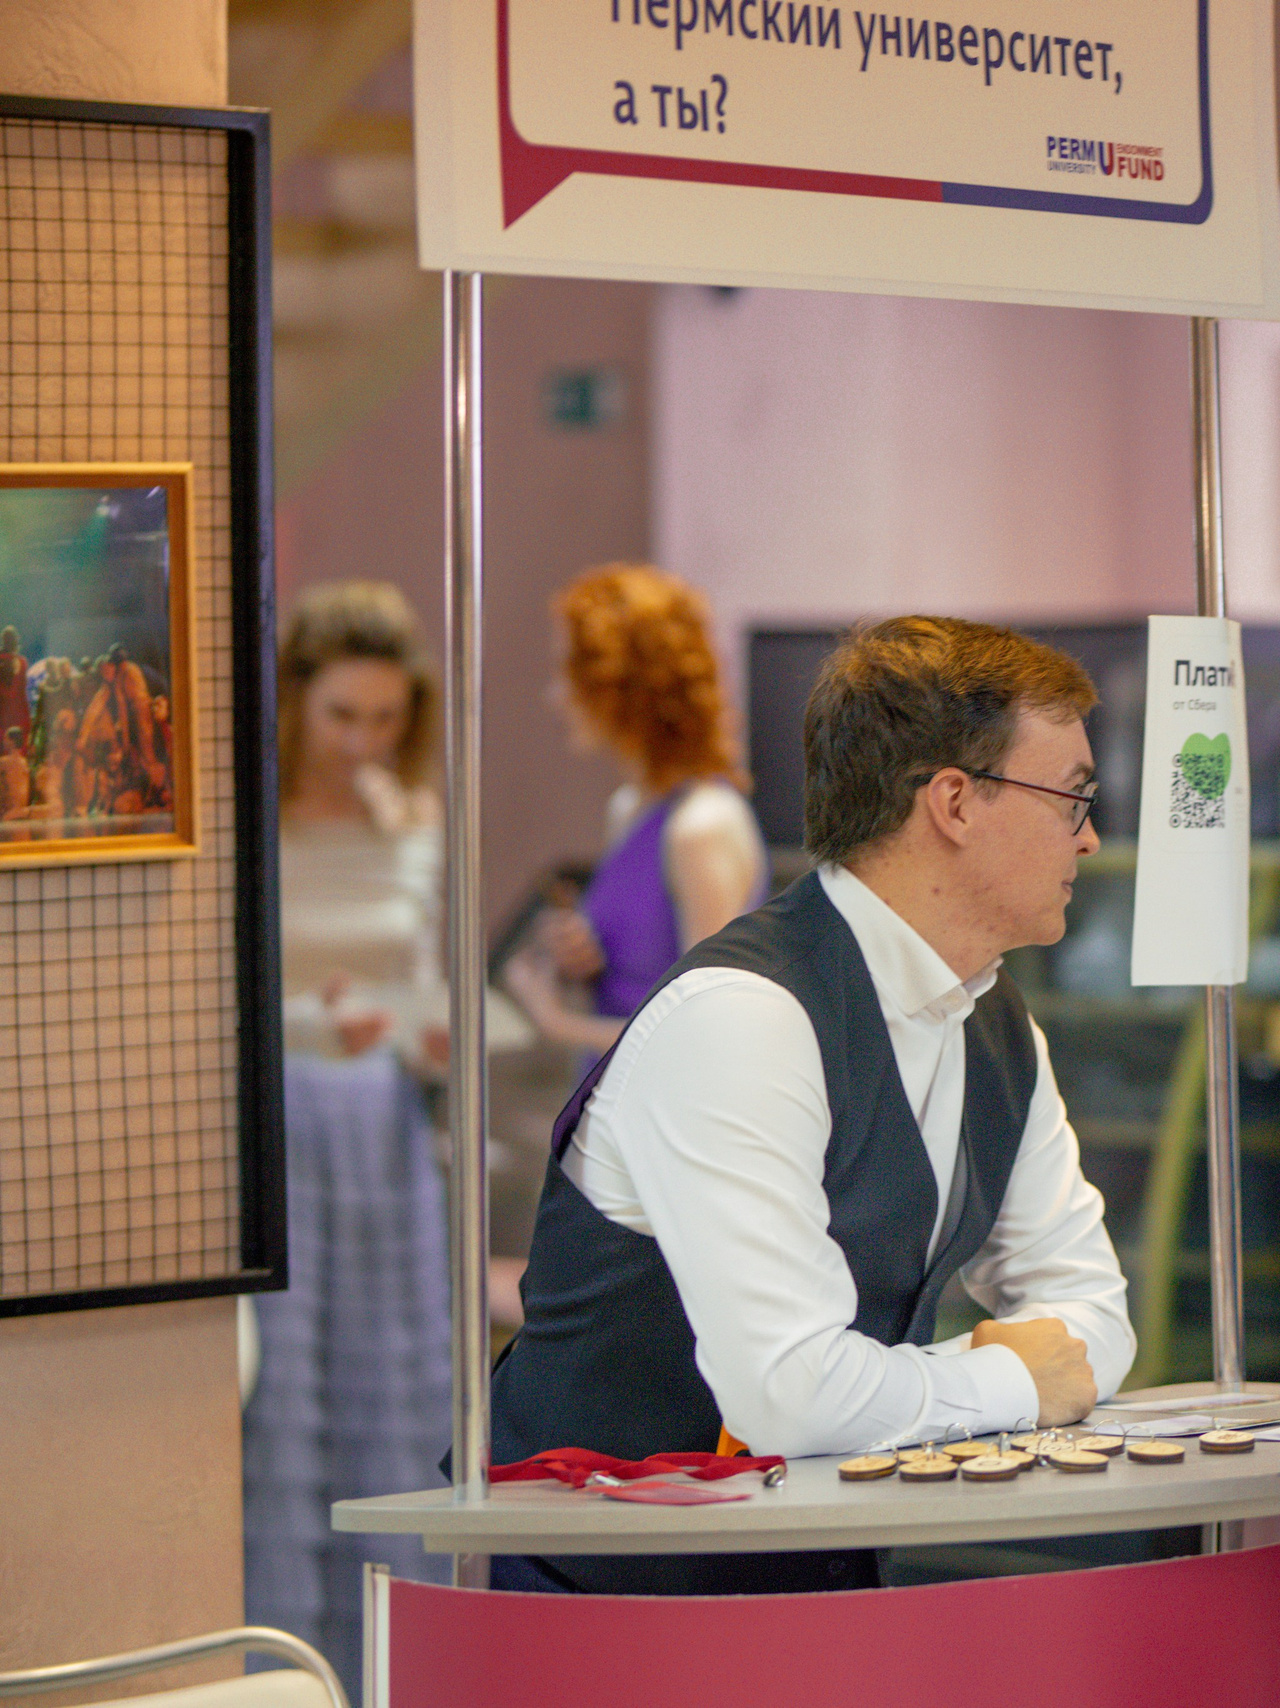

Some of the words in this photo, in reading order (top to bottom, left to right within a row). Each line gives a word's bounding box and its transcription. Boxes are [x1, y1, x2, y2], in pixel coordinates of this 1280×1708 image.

[853, 10, 1123, 95] университет,
[613, 79, 639, 126] а
[650, 73, 729, 135] ты?
[1046, 135, 1096, 162] PERM
[1117, 156, 1165, 181] FUND
